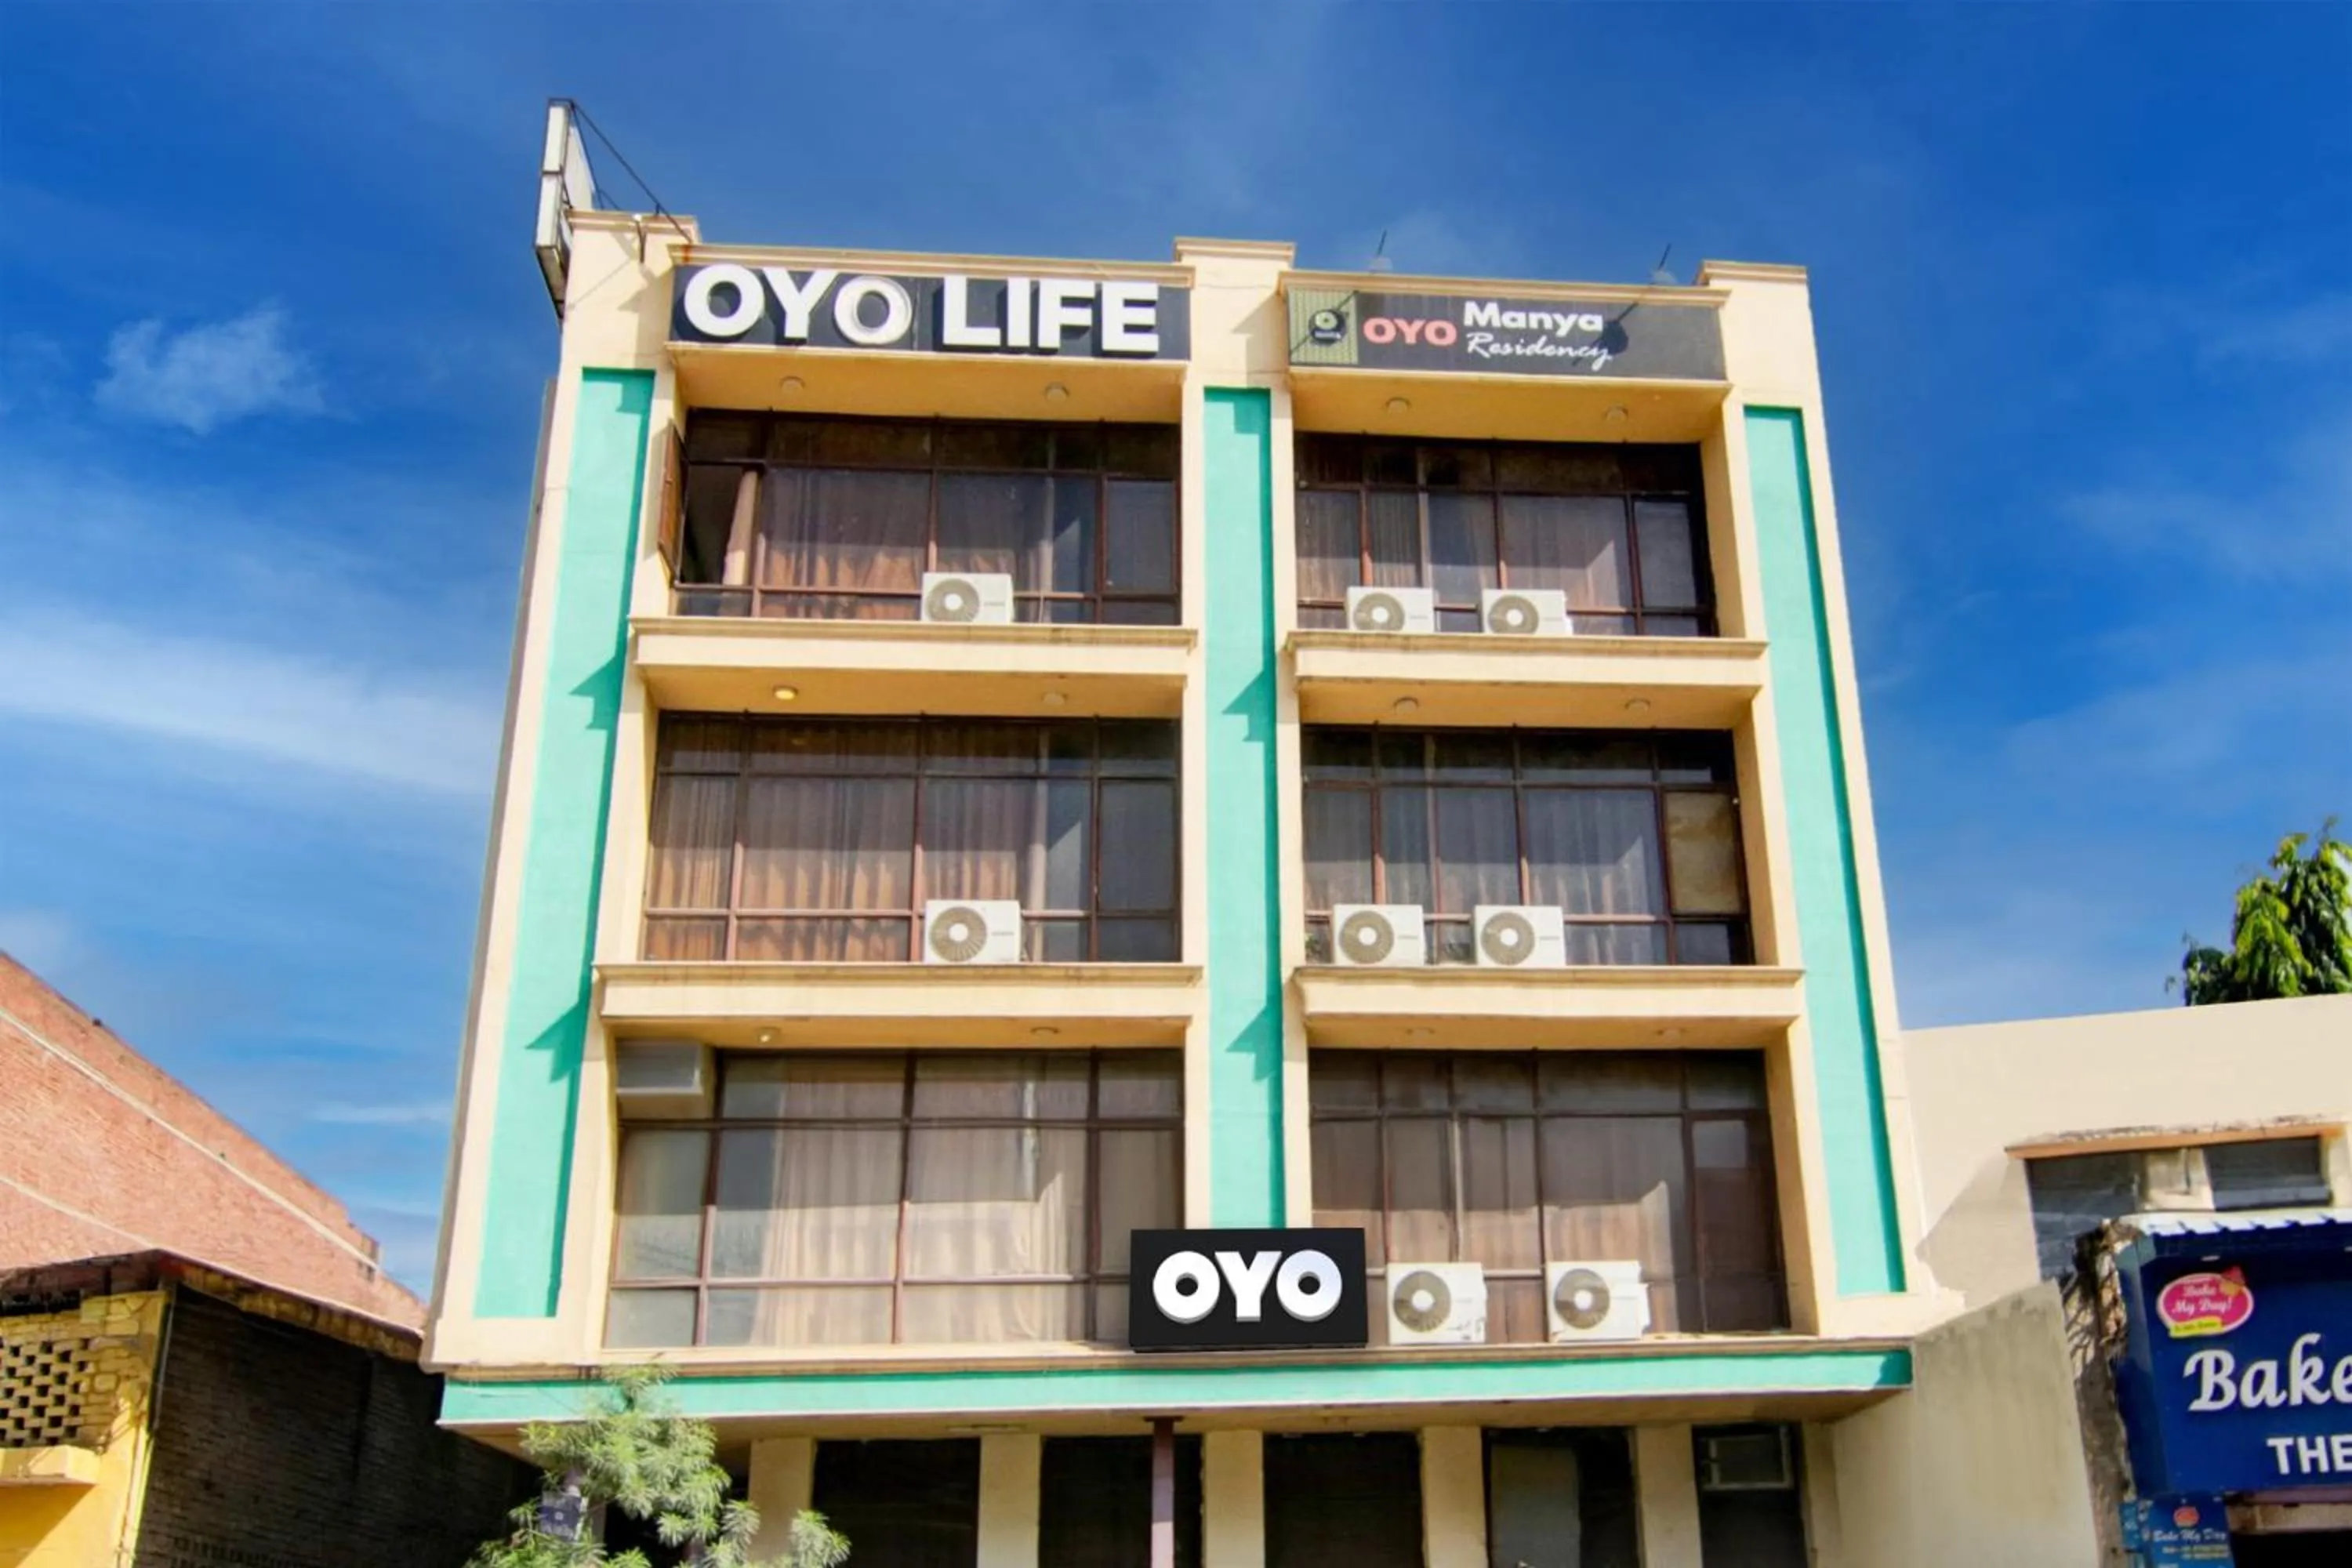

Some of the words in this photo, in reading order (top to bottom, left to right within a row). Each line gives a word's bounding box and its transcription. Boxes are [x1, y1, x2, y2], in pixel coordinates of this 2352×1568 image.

[684, 263, 913, 345] OYO
[942, 275, 1160, 353] LIFE
[1463, 300, 1604, 338] Manya
[1363, 317, 1457, 347] OYO
[1465, 332, 1613, 372] Residency
[1152, 1249, 1343, 1324] OYO
[2182, 1332, 2352, 1411] Bake
[2266, 1434, 2352, 1475] THE
